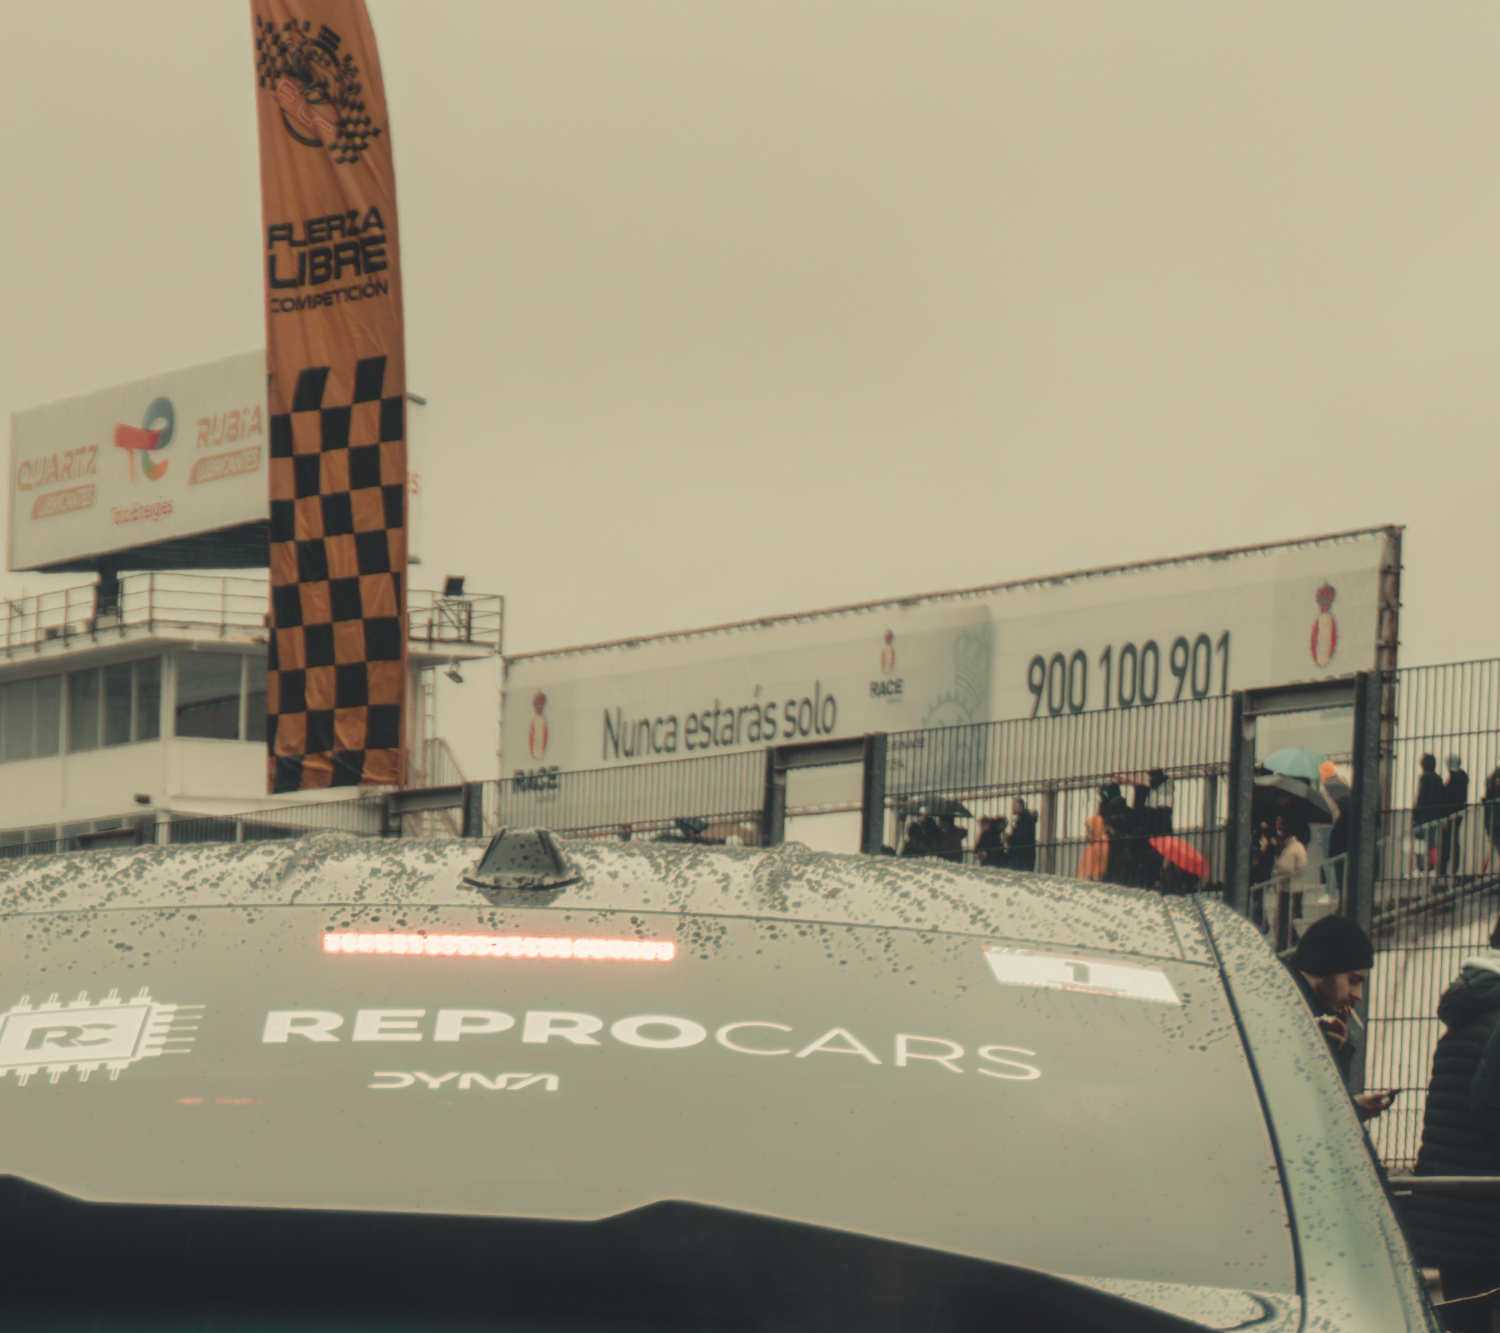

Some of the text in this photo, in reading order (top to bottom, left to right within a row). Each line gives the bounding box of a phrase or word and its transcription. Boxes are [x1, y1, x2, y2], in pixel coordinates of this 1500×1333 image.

[268, 233, 388, 289] LIBRE
[270, 275, 388, 314] COMPETICIÓN
[17, 443, 99, 492] QUARTZ
[869, 678, 904, 698] RACE
[1027, 629, 1231, 719] 900 100 901
[602, 679, 837, 760] Nunca estarás solo
